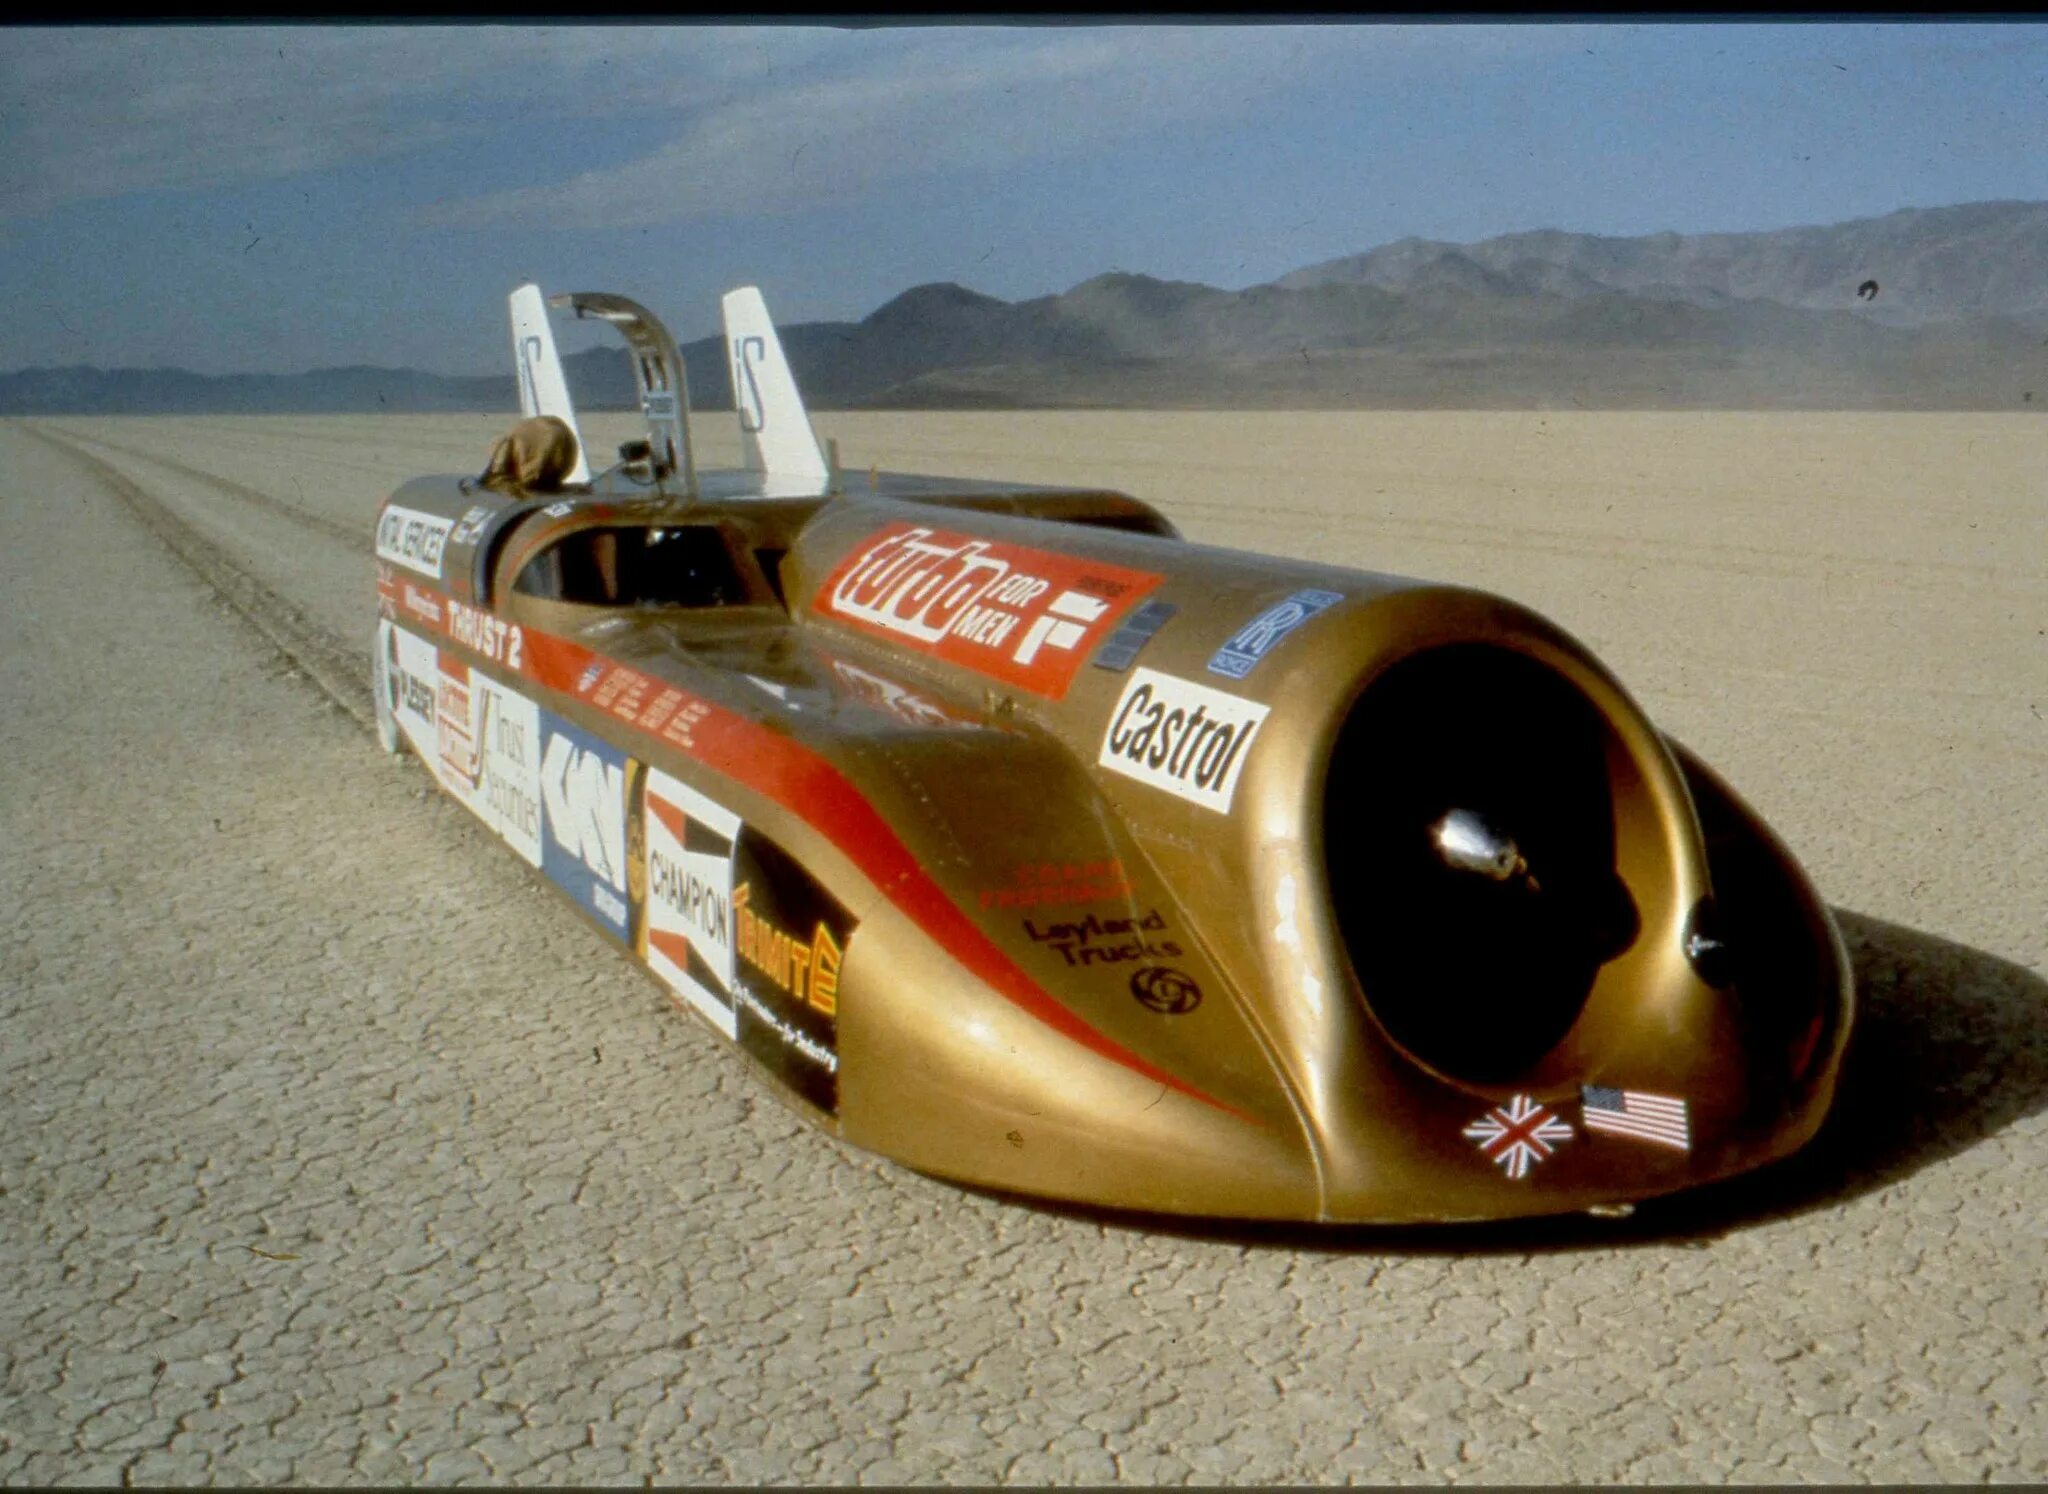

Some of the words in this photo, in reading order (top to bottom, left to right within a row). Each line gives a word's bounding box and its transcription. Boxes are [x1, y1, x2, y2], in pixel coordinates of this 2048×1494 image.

[986, 573, 1050, 608] FOR
[448, 600, 507, 661] THRUST
[508, 625, 523, 670] 2
[953, 604, 1020, 648] MEN
[1108, 682, 1258, 794] Castrol
[650, 847, 729, 949] CHAMPION
[1022, 908, 1167, 945] Leyland
[1048, 936, 1185, 967] Trucks
